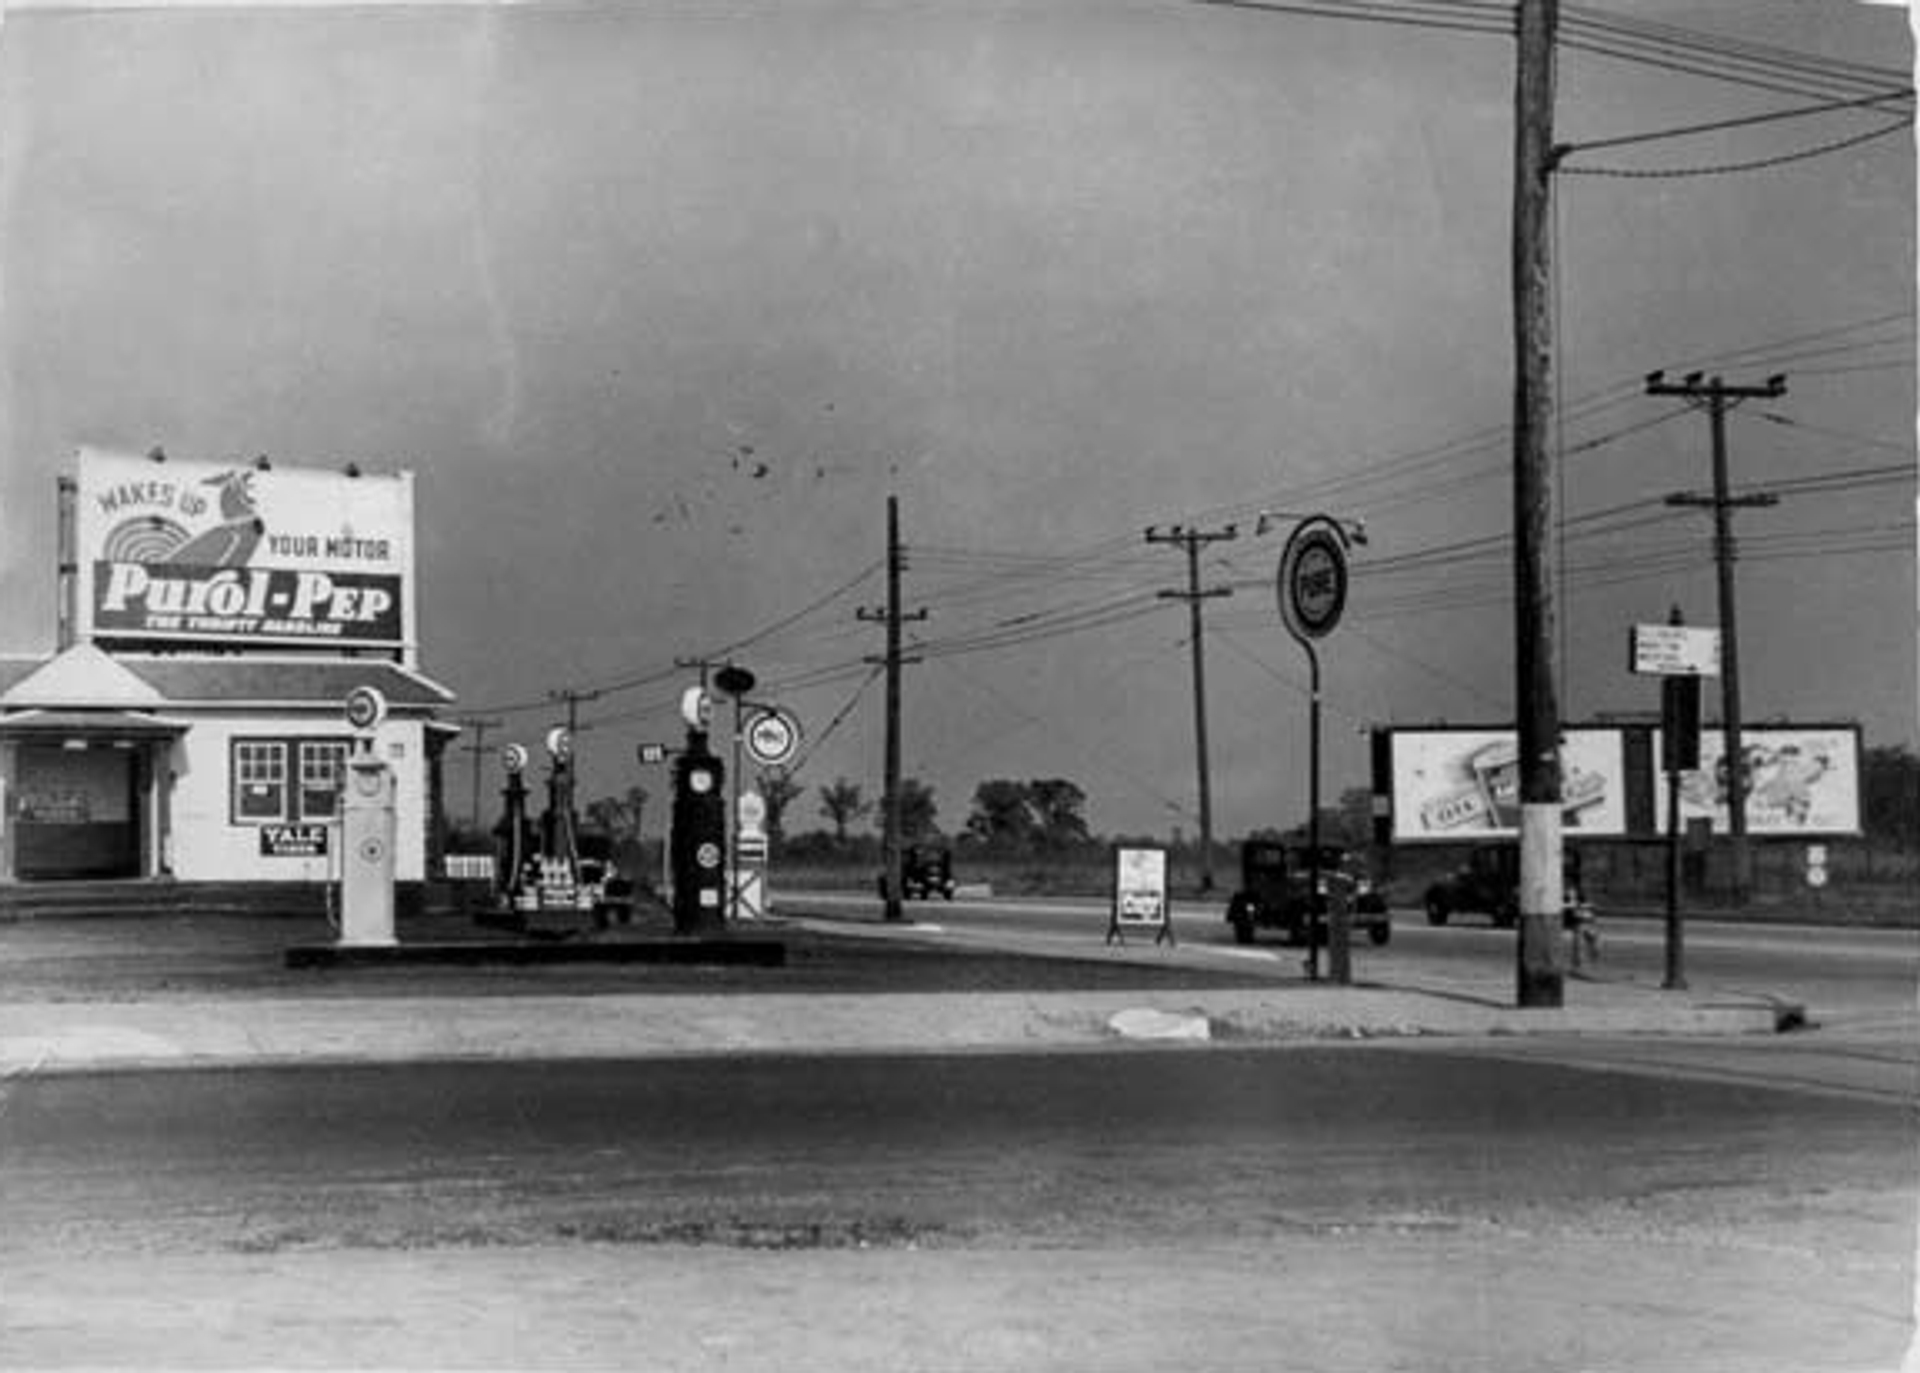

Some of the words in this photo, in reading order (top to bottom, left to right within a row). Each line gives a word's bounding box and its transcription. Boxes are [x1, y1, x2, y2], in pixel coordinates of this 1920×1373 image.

[97, 481, 175, 514] MAKES
[180, 491, 208, 517] UP
[270, 536, 318, 558] YOUR
[327, 537, 389, 560] MOTOR
[265, 826, 324, 844] YALE
